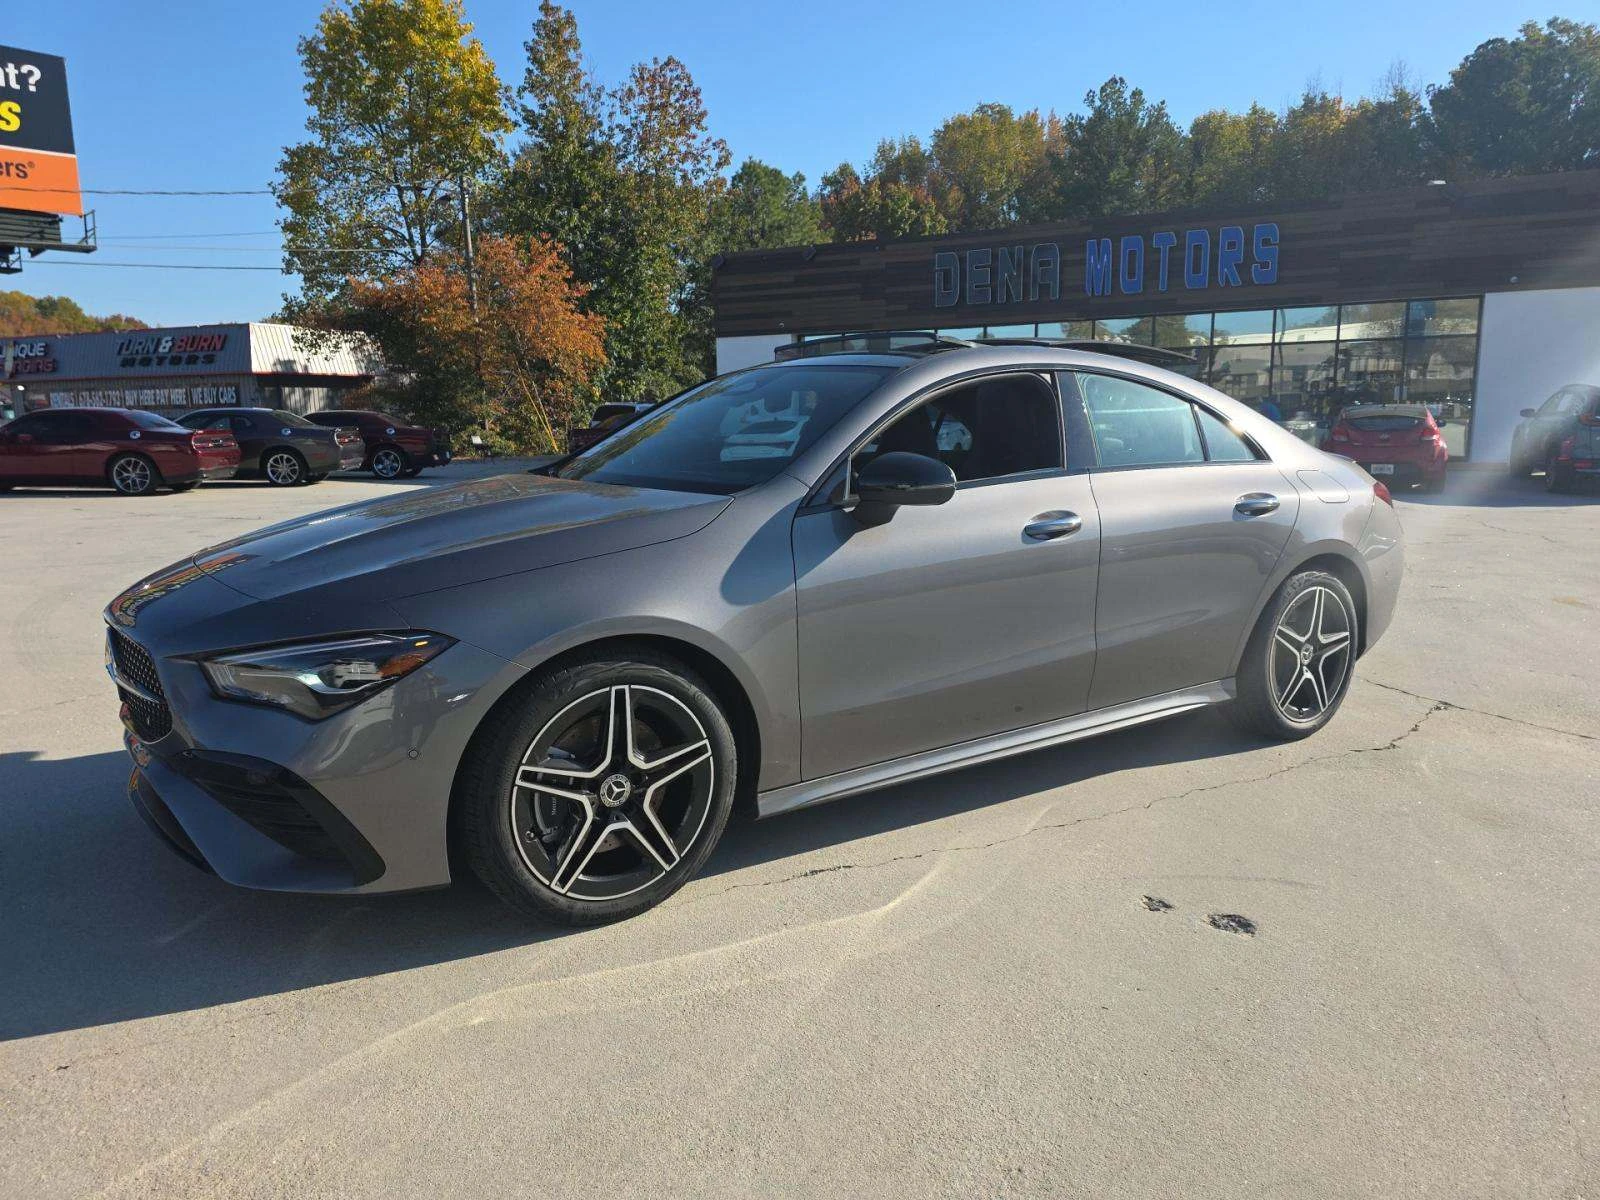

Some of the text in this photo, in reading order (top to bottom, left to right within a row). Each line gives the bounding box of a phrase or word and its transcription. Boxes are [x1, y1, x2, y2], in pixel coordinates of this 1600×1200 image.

[934, 223, 1281, 308] DENA MOTORS
[116, 333, 228, 355] TURN & BURN
[120, 354, 216, 368] MOTORS
[218, 386, 236, 404] CARS
